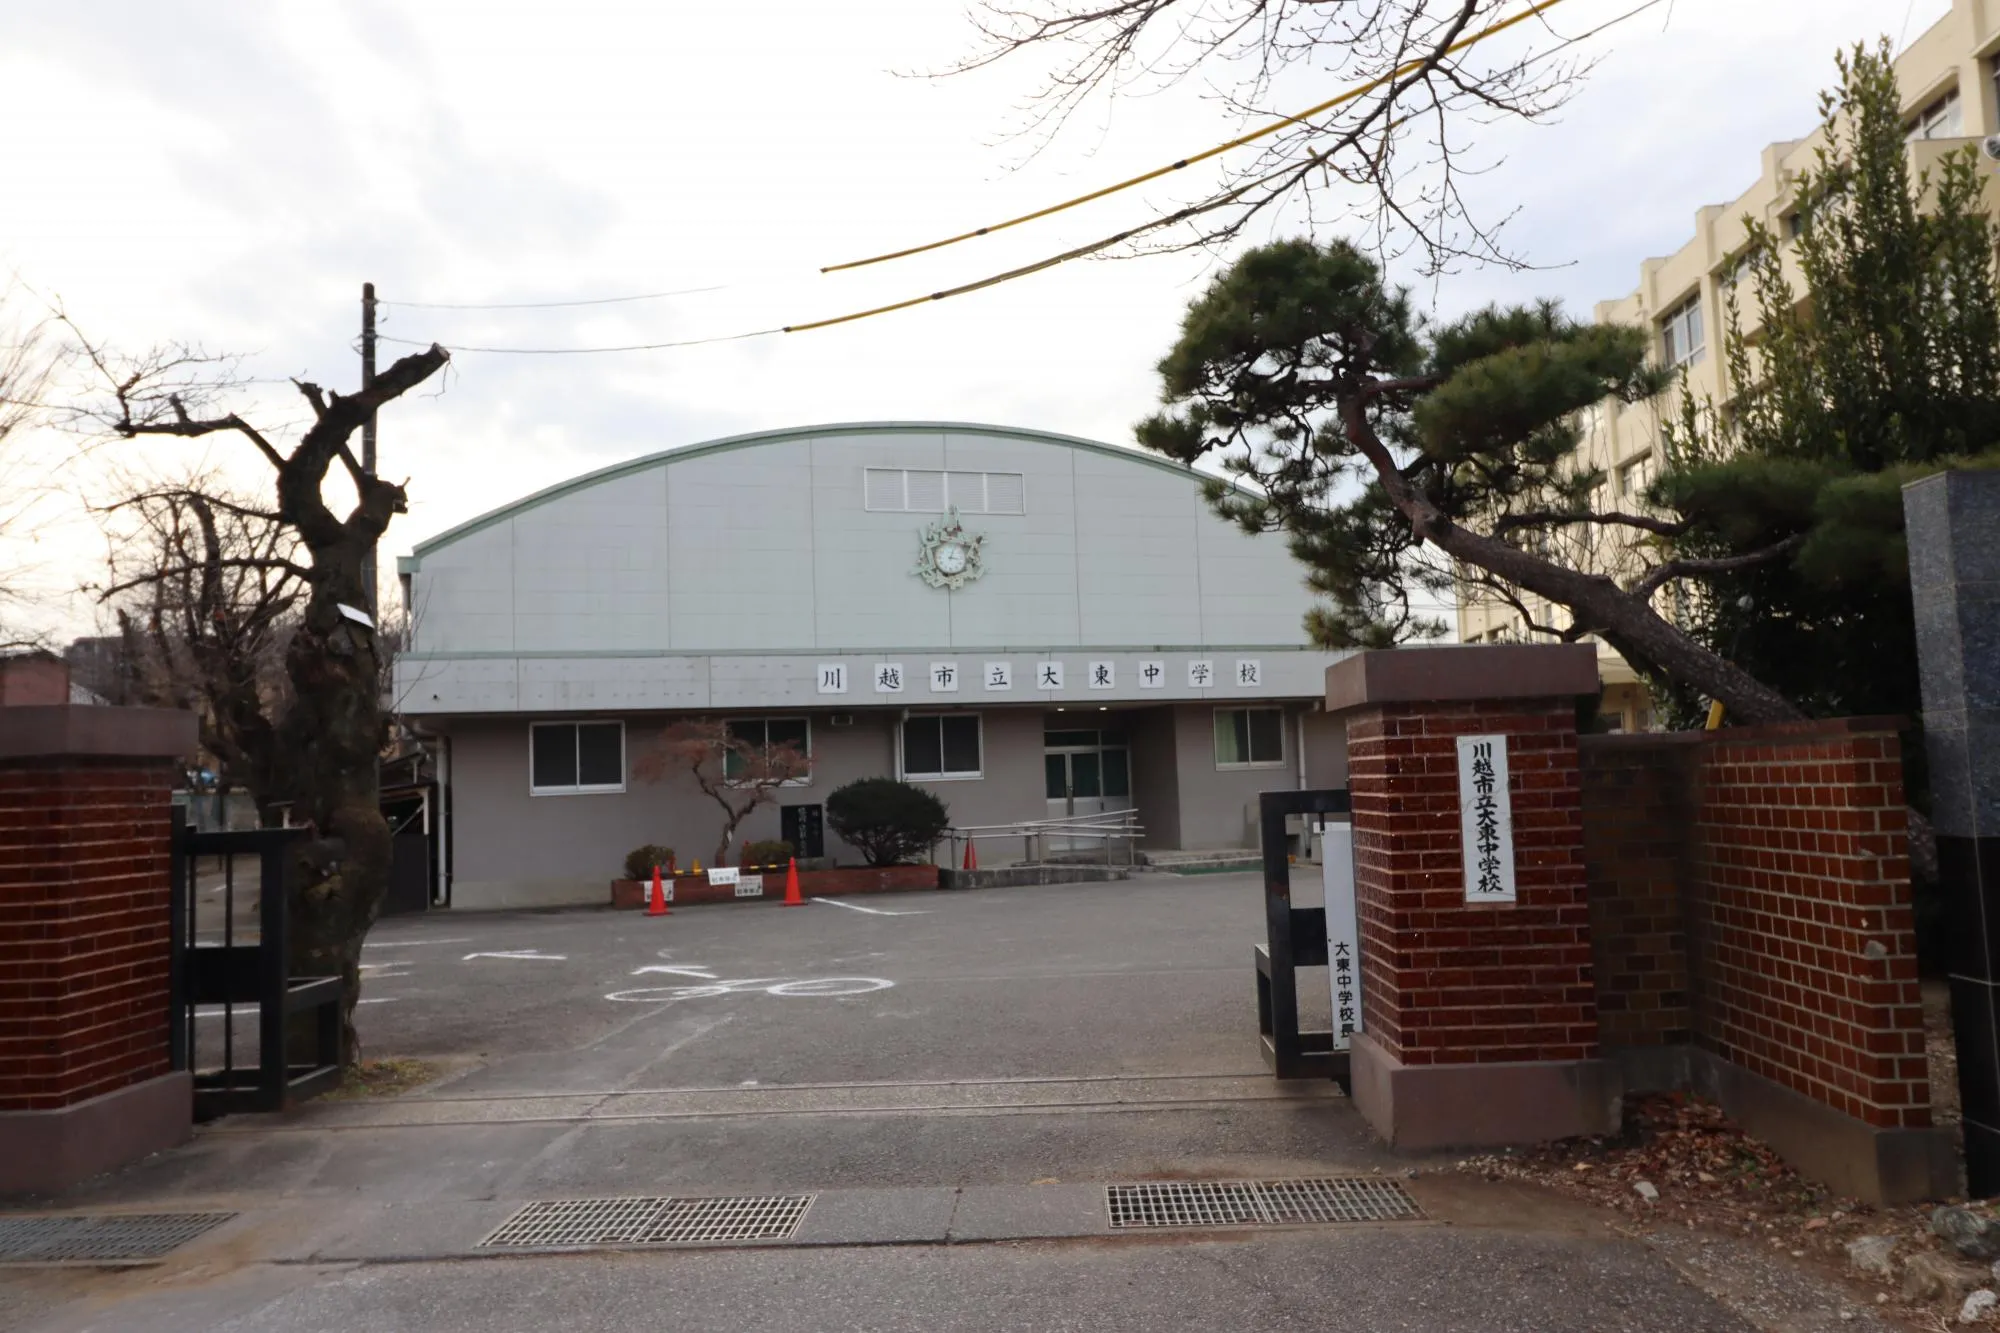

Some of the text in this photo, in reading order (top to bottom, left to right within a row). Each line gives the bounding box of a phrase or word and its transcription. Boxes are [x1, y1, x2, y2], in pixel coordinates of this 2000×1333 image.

[823, 663, 1257, 689] 川越市立大東中学校
[1472, 742, 1503, 893] 川越市立大東中学校
